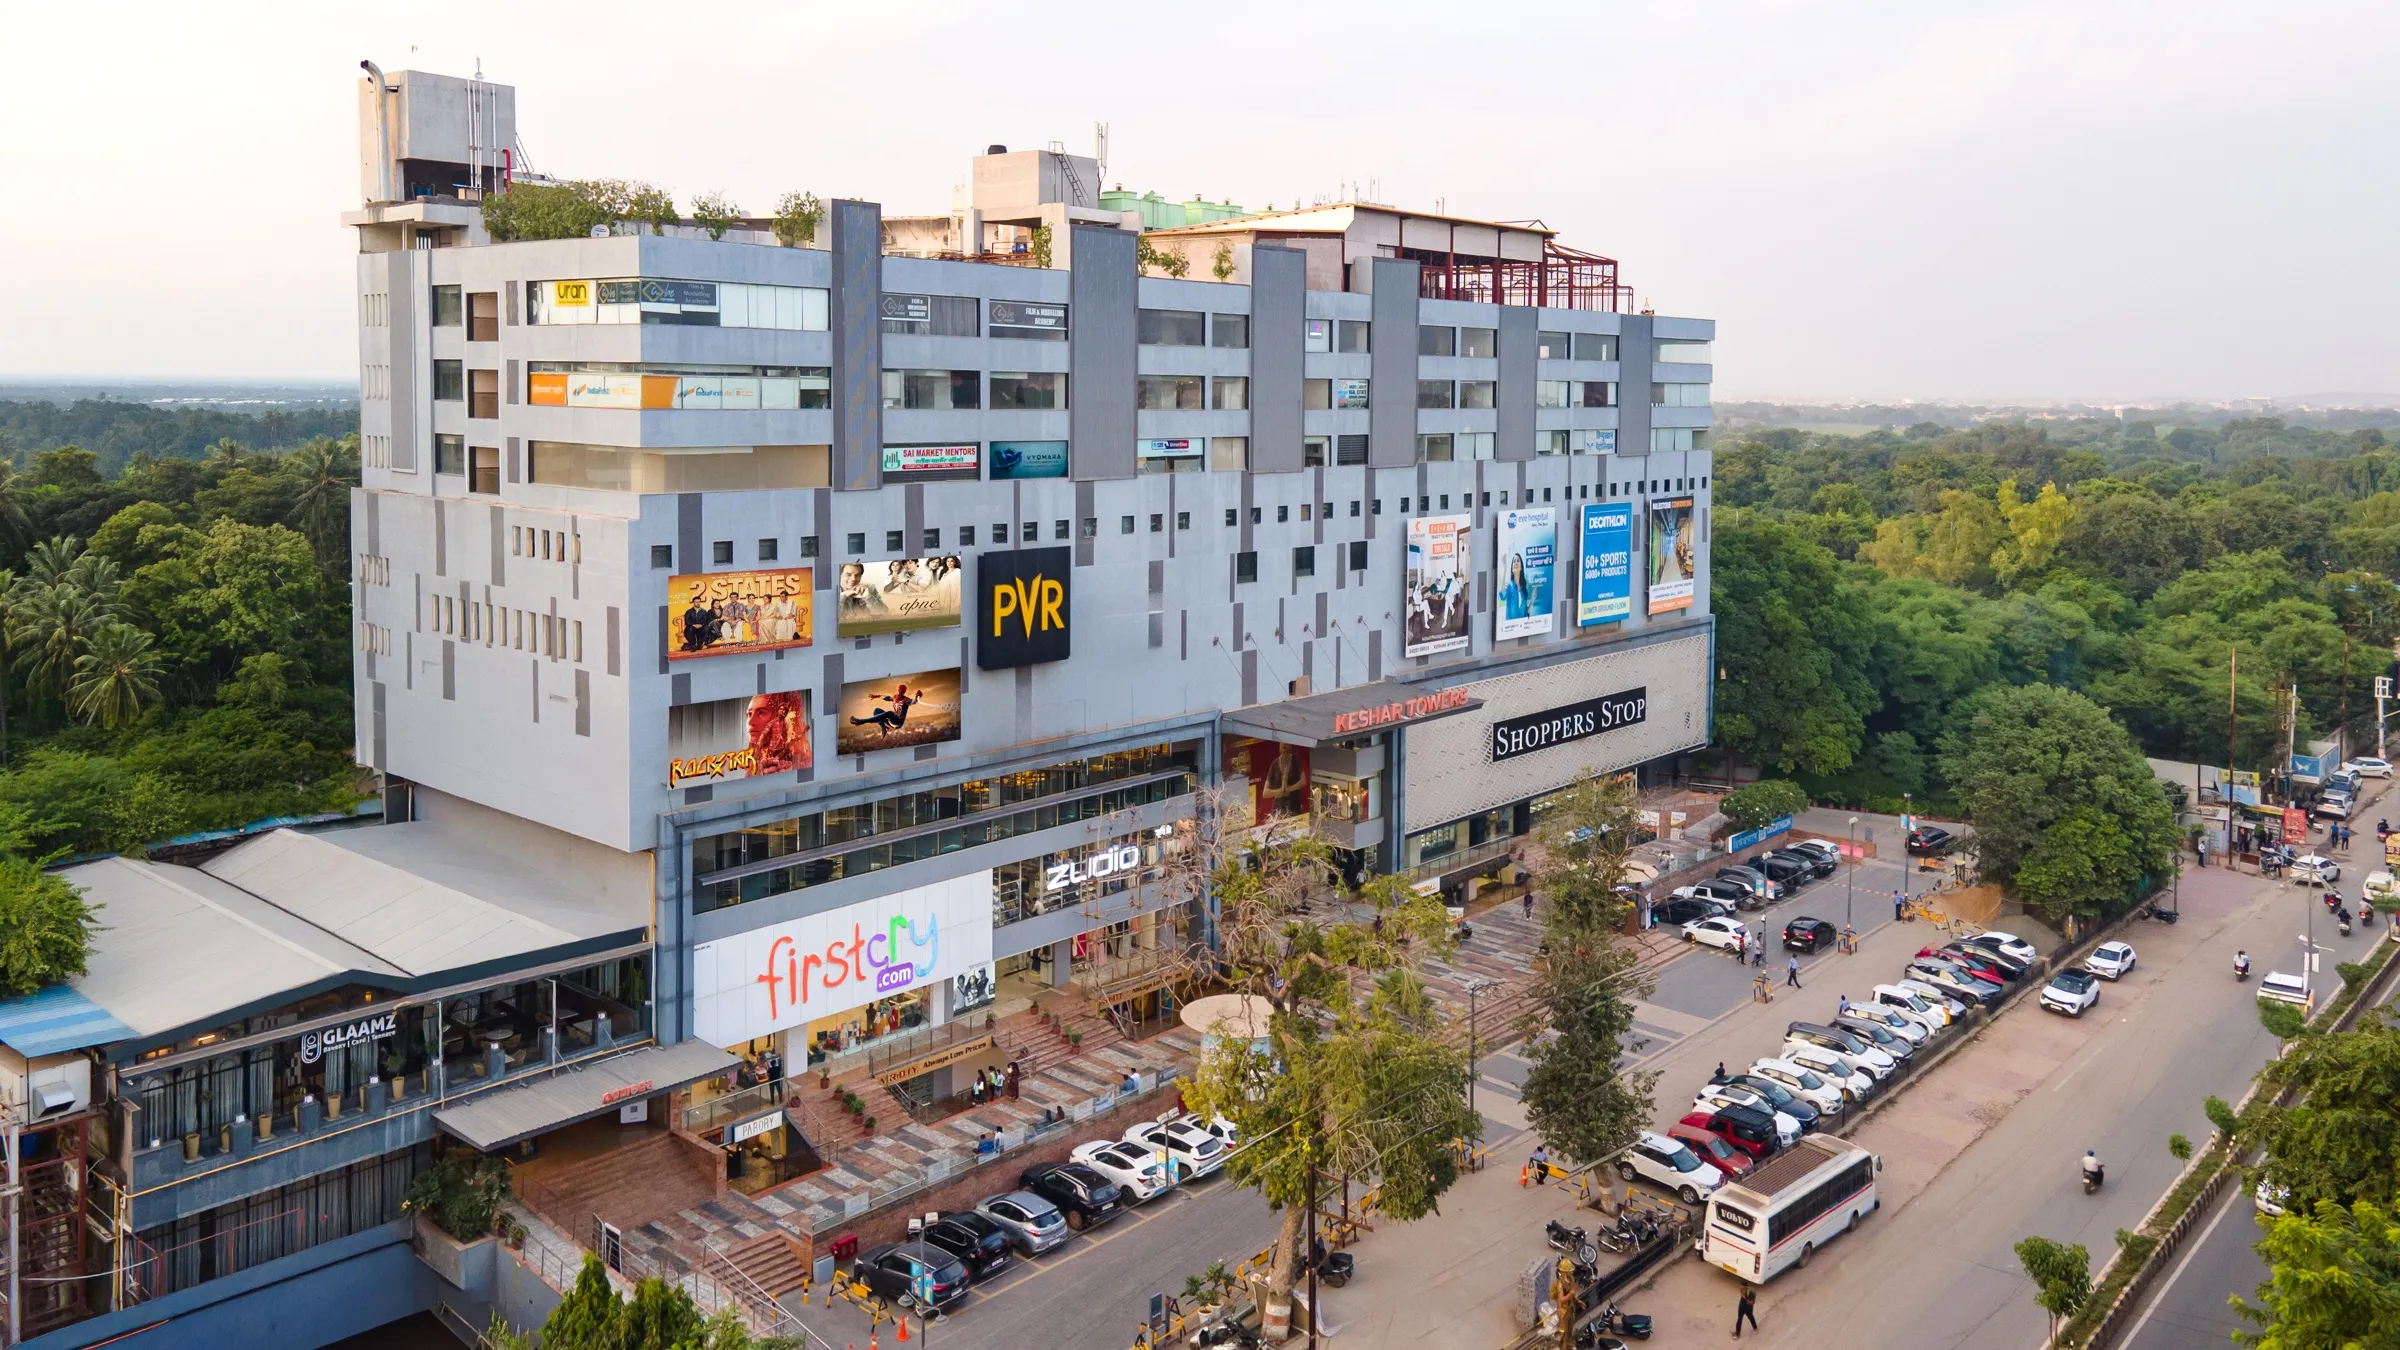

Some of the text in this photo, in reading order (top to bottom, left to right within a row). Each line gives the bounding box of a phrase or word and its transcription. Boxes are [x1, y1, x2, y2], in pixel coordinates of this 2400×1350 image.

[557, 282, 587, 299] uran
[903, 447, 976, 458] SAI MARKET MENTORS
[1528, 512, 1549, 522] hospital
[1588, 514, 1627, 530] DECATHLON
[1585, 551, 1627, 569] 60+ SPORTS
[1585, 566, 1627, 580] 6000+ PRODUCTS
[689, 580, 707, 603] 2
[711, 574, 801, 601] STATES
[899, 598, 938, 615] apne
[994, 572, 1065, 641] PVR
[1584, 605, 1598, 615] LOWER
[1598, 603, 1613, 613] GROUND
[1335, 688, 1469, 733] KESHAR TOWERS
[1496, 698, 1645, 756] SHOPPERS STOP
[670, 748, 757, 789] ROCKSTAR
[757, 912, 938, 1020] firstcry .com
[323, 1014, 396, 1045] GLAAMZ
[923, 1055, 949, 1070] Always
[950, 1050, 964, 1060] Low
[965, 1042, 987, 1054] Prices
[1721, 1208, 1749, 1227] VOLVO
